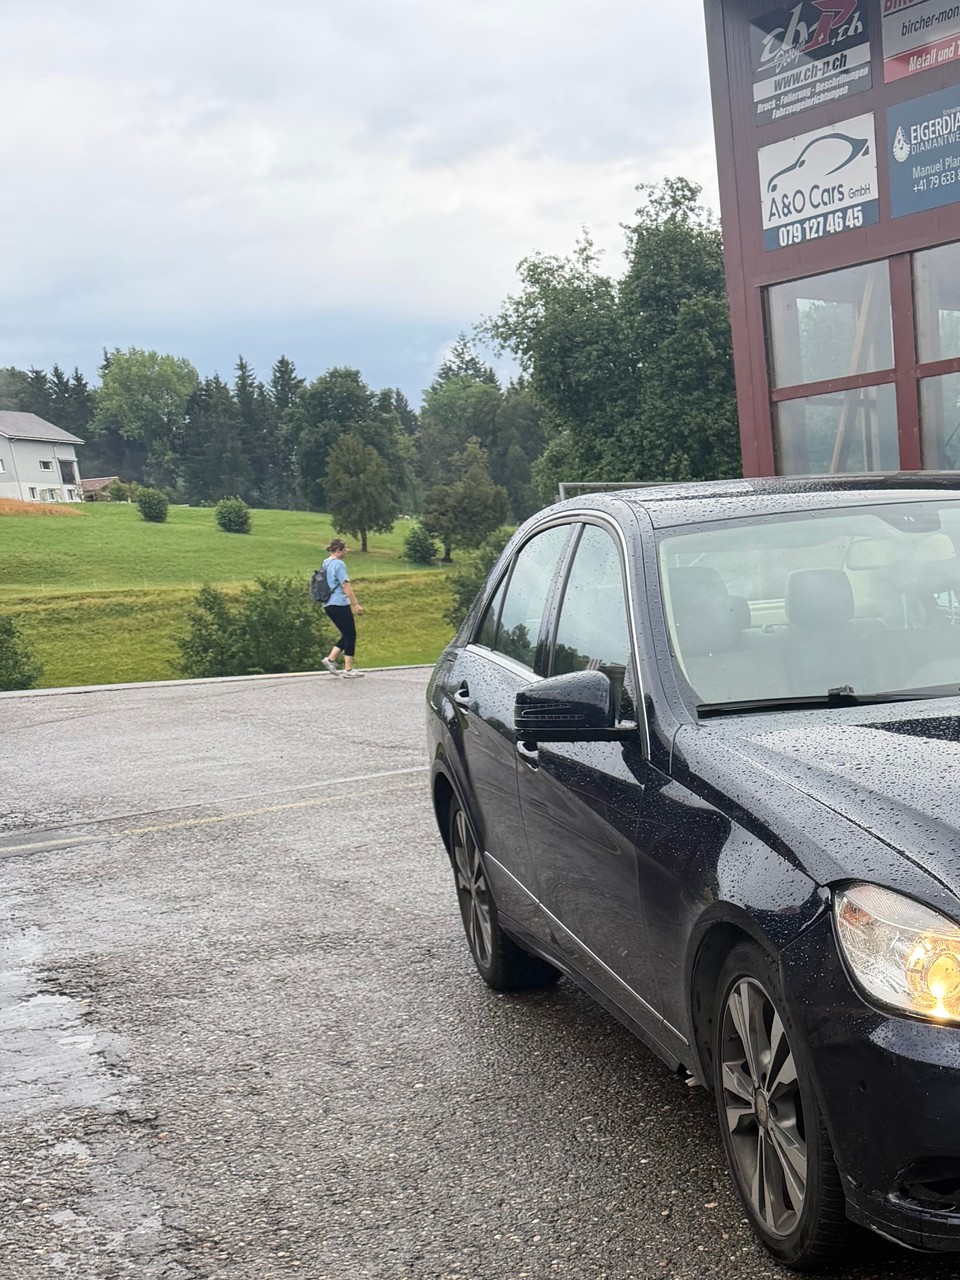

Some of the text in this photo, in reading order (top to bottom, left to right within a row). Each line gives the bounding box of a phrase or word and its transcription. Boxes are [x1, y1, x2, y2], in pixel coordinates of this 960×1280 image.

[774, 53, 847, 92] www.ch-p.ch
[909, 54, 936, 72] Metall
[938, 46, 955, 62] und
[912, 159, 943, 179] Manuel
[913, 179, 927, 192] +41
[930, 175, 939, 189] 79
[941, 170, 956, 186] 633
[768, 183, 871, 222] A&O Cars GmbH
[779, 206, 863, 247] 079 127 46 45
